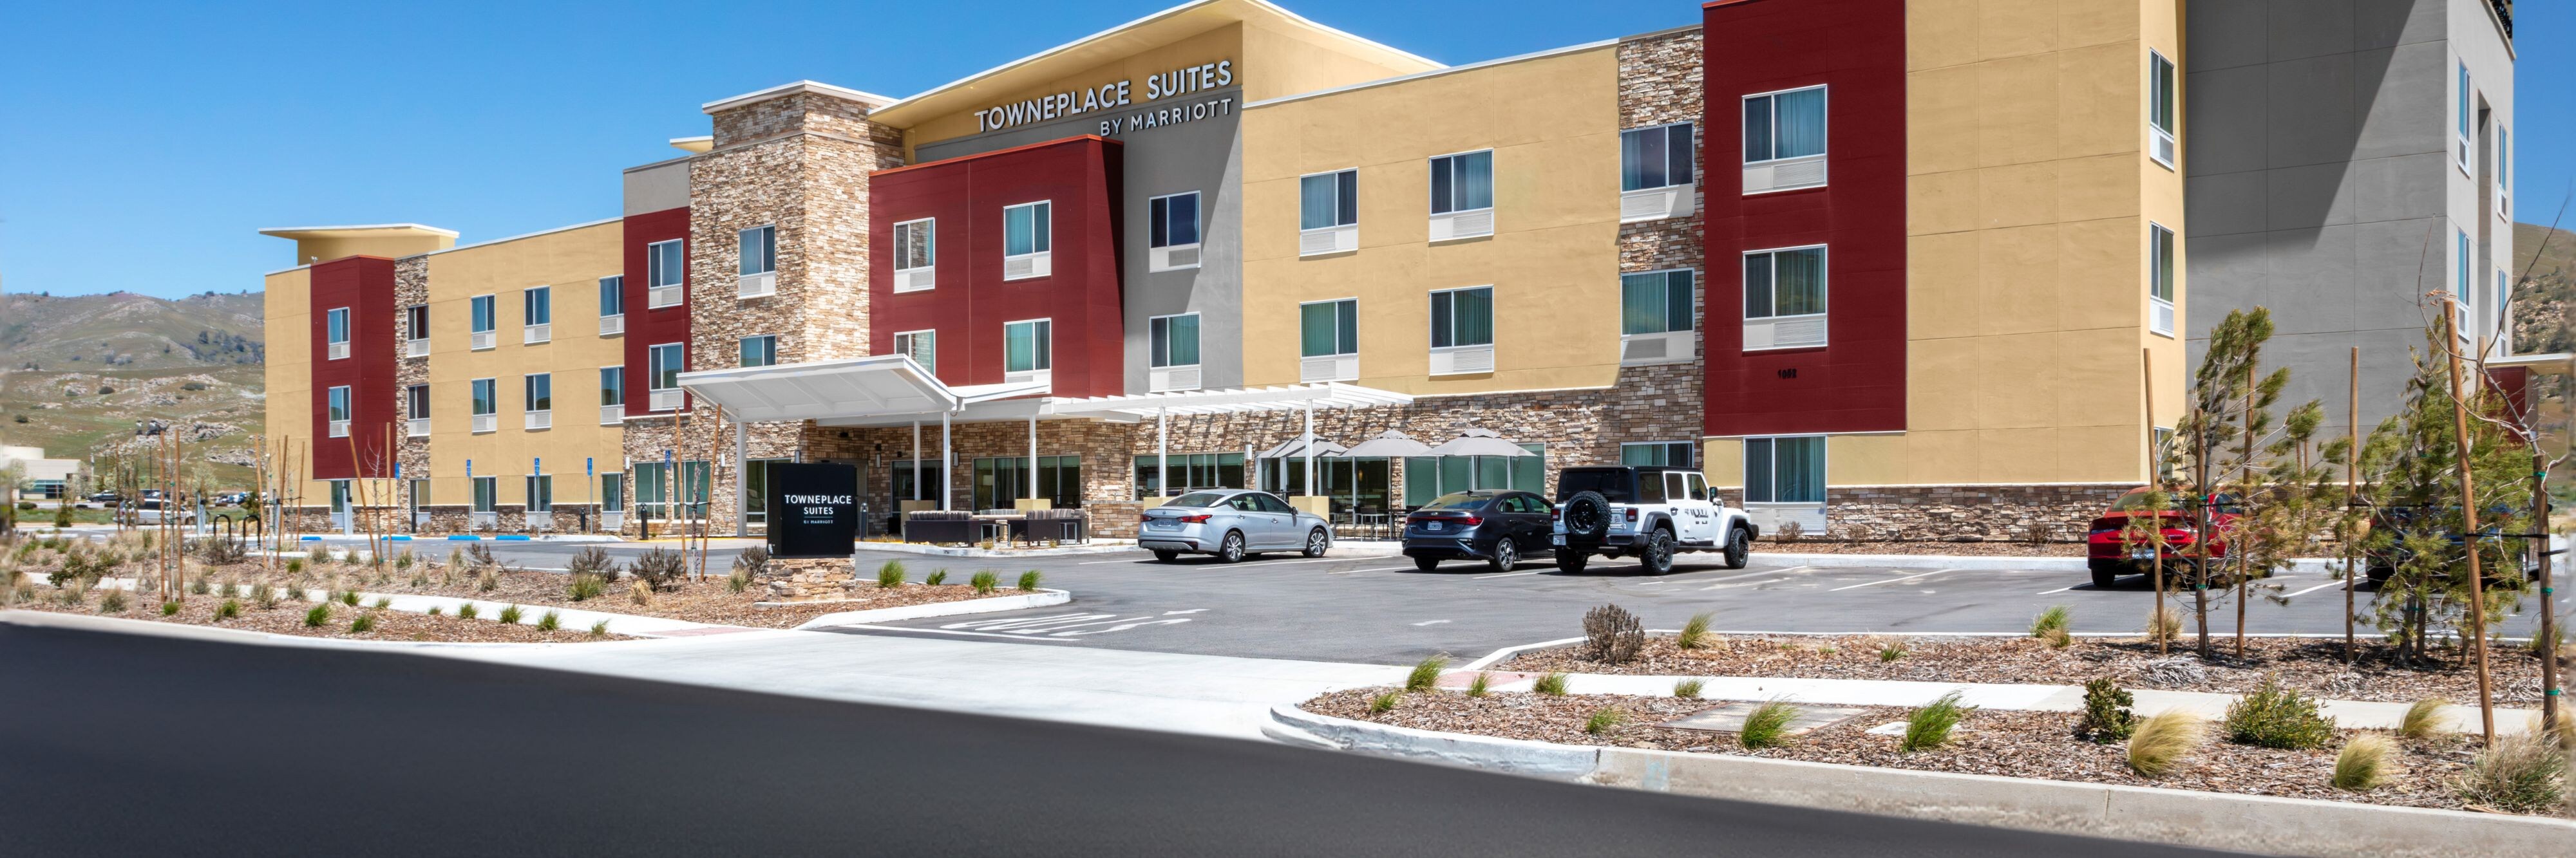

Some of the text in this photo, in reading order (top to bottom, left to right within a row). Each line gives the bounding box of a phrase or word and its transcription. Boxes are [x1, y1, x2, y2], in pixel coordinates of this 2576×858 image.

[974, 60, 1233, 132] TOWNEPLACE SUITES
[1100, 98, 1232, 136] BY MARRIOTT
[784, 494, 852, 504] TOWNEPLACE
[940, 612, 1192, 637] STOP
